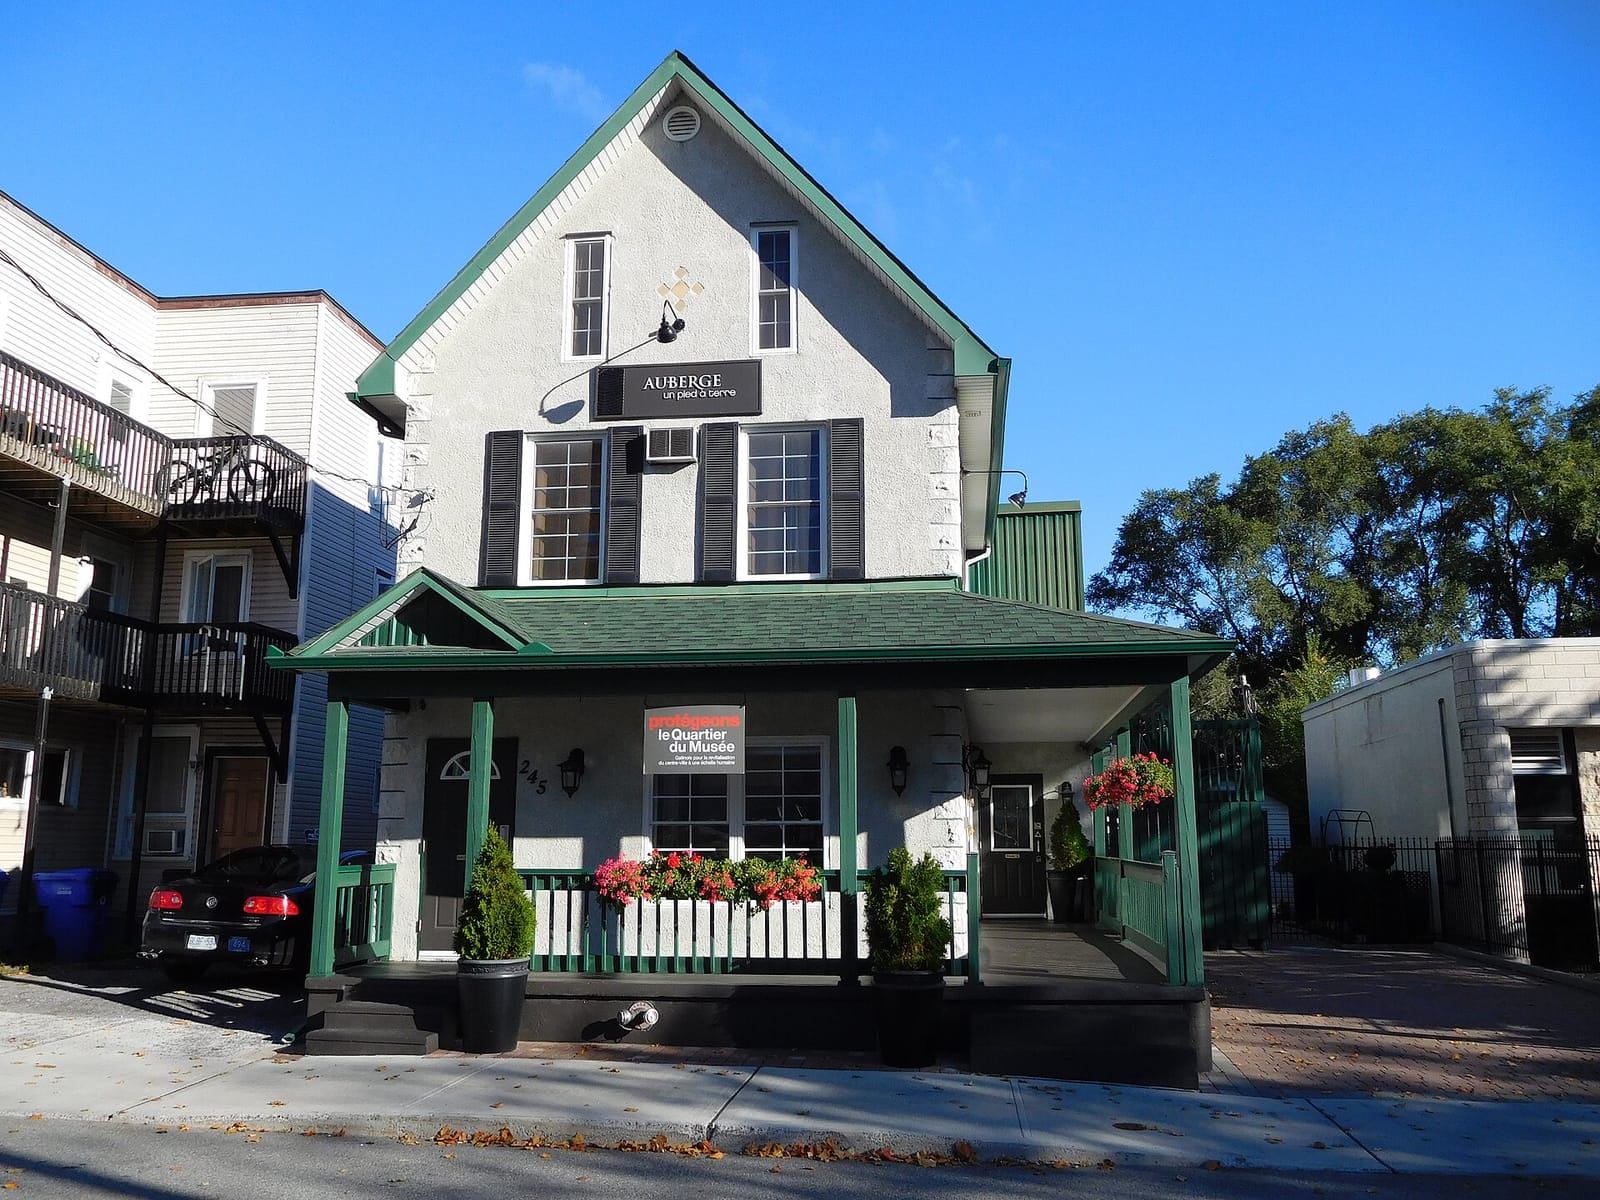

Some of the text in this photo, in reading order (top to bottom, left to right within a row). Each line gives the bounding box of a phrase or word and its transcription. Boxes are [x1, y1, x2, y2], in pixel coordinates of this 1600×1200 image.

[643, 374, 722, 389] AUBERGE
[663, 389, 736, 401] un pied à terre
[649, 713, 740, 730] protégeons
[658, 728, 727, 741] le Quartier
[669, 740, 735, 752] du Musée
[519, 760, 548, 795] 245
